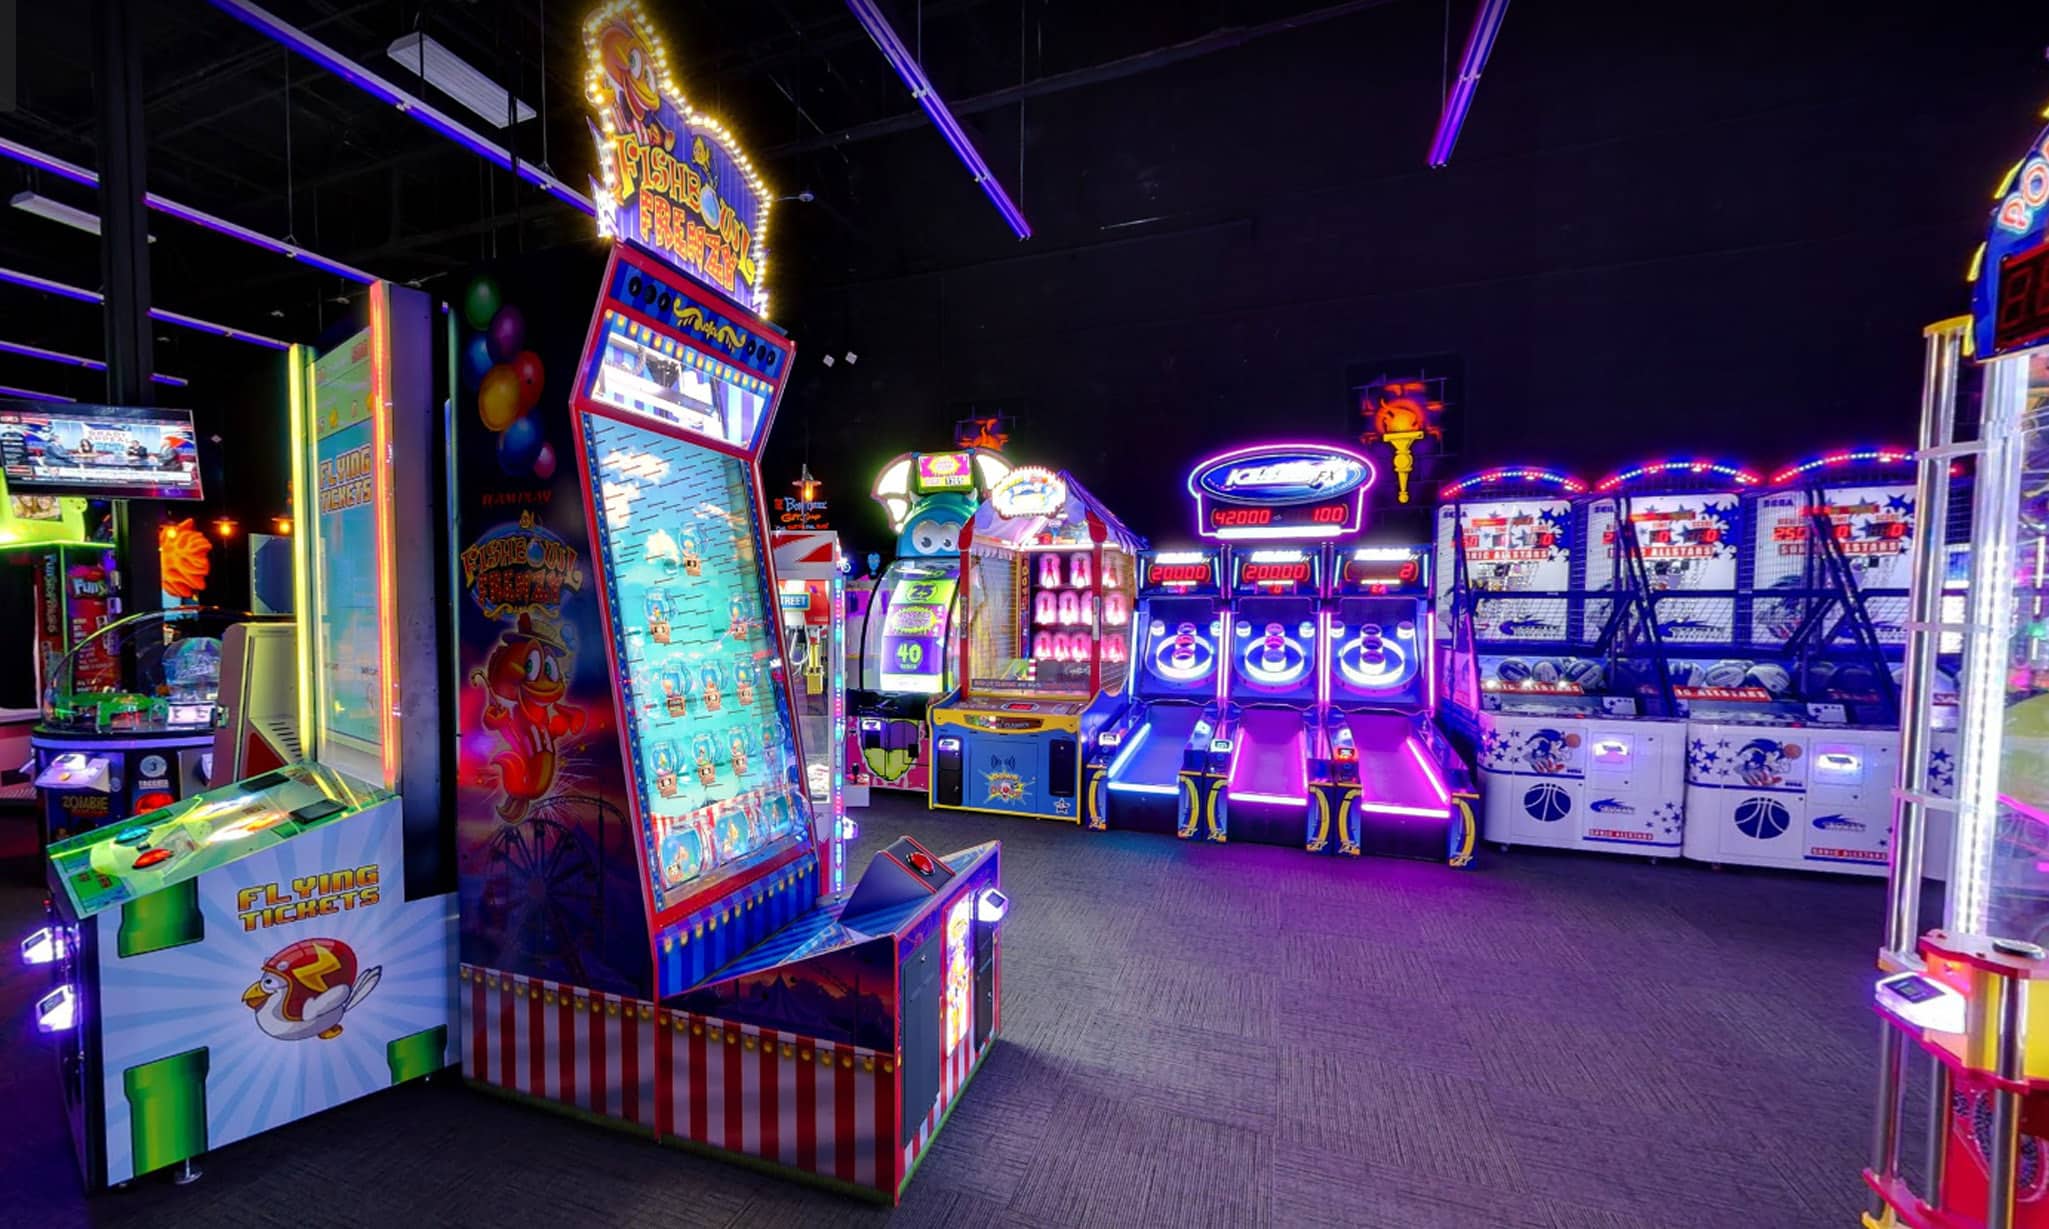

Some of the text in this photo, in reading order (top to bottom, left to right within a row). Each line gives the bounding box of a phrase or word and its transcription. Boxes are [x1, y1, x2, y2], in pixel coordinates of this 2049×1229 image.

[1997, 133, 2049, 235] PO
[638, 185, 738, 292] FRENZY
[1215, 507, 1344, 525] 42000 100
[1151, 564, 1207, 581] 20000
[1245, 563, 1305, 580] 20000
[780, 595, 807, 606] TREET
[897, 643, 923, 664] 40
[237, 864, 380, 912] FLYING
[239, 886, 380, 932] TICKETS
